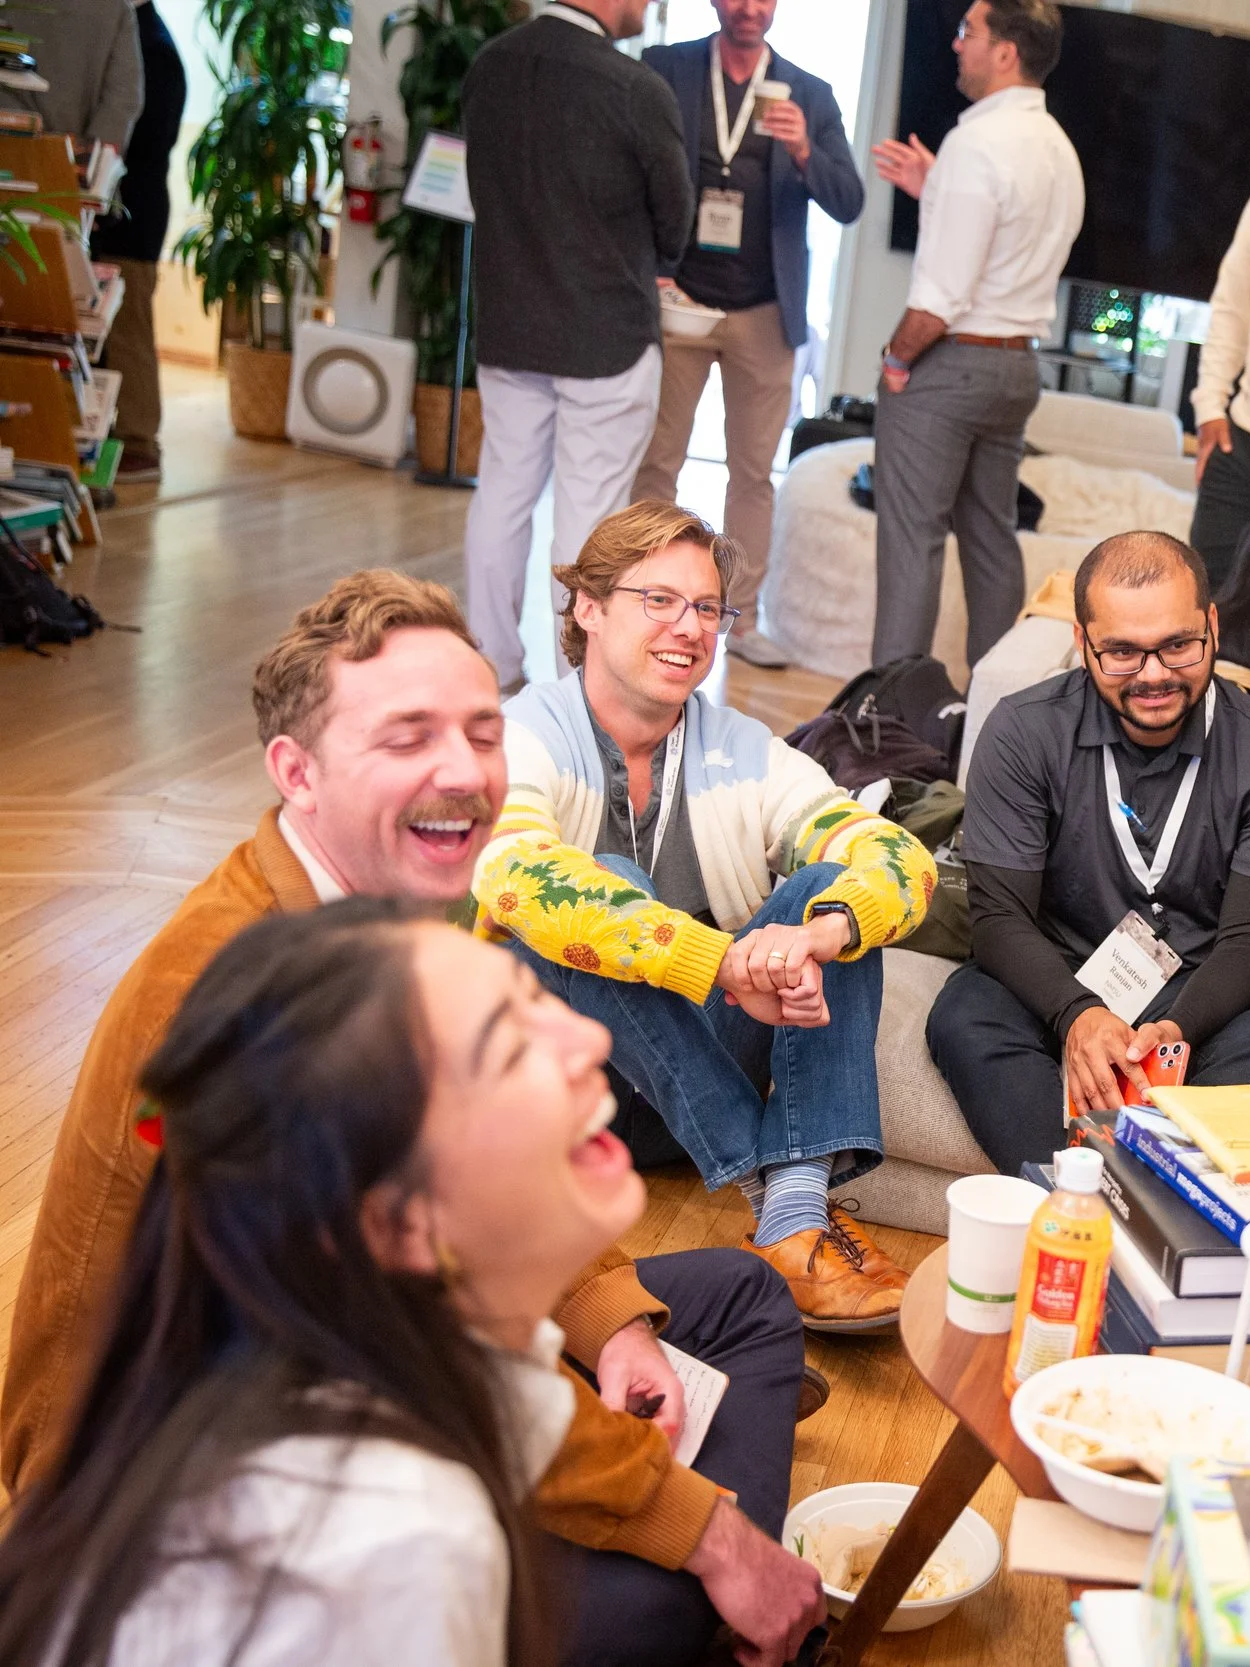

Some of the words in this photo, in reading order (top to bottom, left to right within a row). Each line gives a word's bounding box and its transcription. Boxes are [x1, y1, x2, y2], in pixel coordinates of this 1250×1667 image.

[1109, 966, 1133, 992] Ranjan
[1112, 948, 1148, 990] Venkatesh
[1136, 1133, 1178, 1180] industrial
[1177, 1172, 1237, 1232] megaprojects
